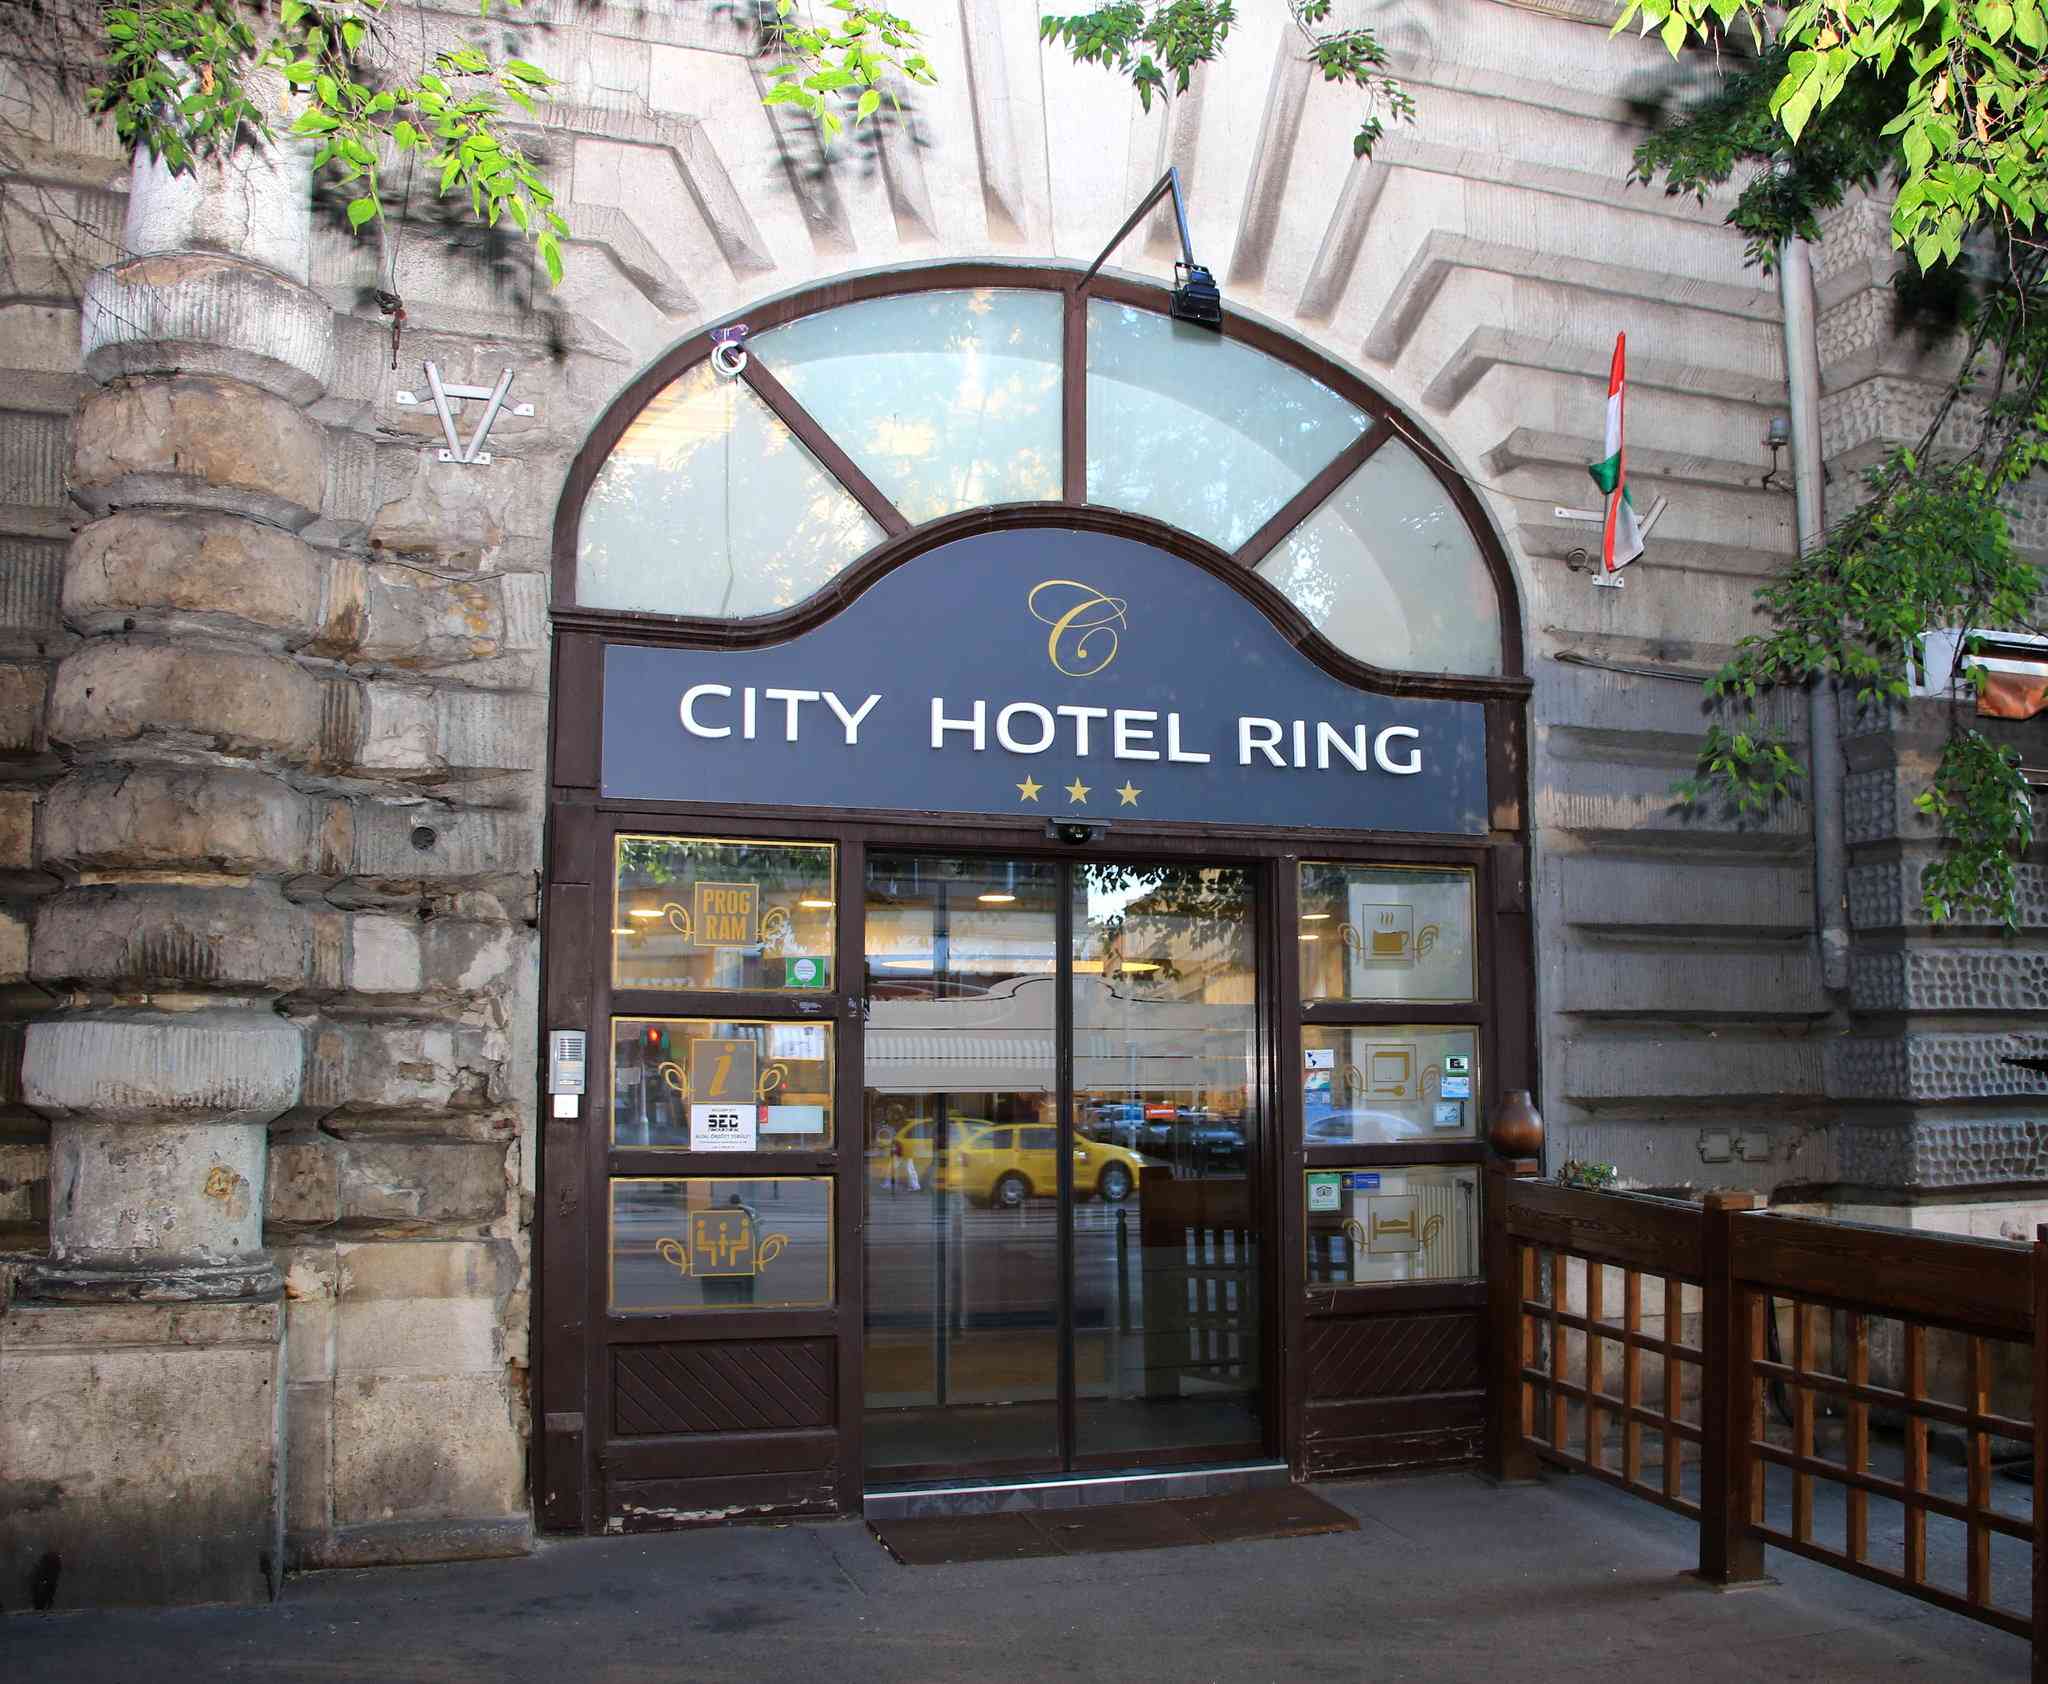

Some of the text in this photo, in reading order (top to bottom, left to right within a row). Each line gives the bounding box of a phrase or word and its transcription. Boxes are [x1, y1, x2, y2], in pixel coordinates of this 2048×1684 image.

[679, 683, 1423, 775] CITY HOTEL RING
[703, 888, 751, 914] PROG
[705, 914, 747, 941] RAM
